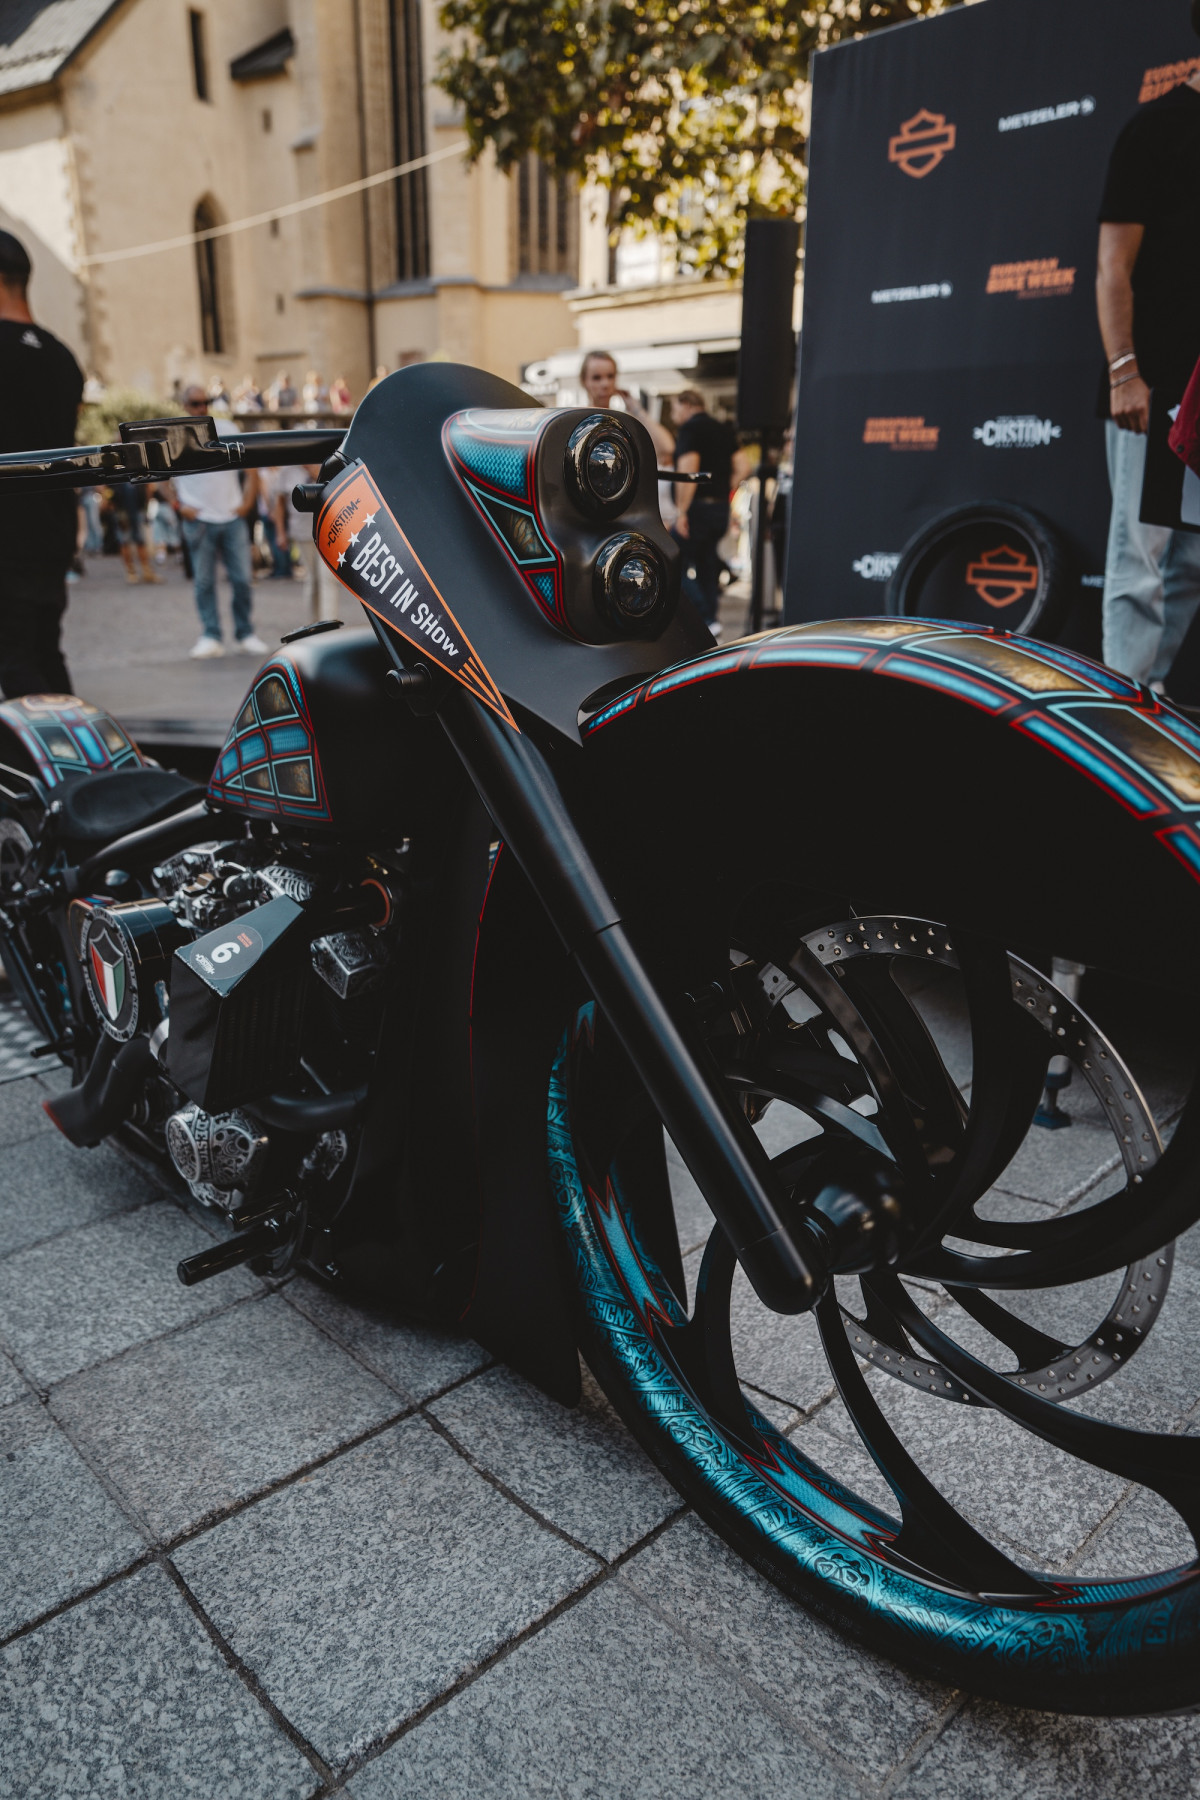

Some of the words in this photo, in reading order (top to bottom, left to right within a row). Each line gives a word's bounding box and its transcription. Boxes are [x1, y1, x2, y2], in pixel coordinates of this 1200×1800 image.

[998, 100, 1081, 132] METZELER
[871, 284, 939, 303] METZELER
[986, 275, 1025, 294] BIKE
[1027, 267, 1077, 289] WEEK
[897, 427, 940, 442] WEEK
[982, 418, 1052, 446] CUSTOM
[329, 502, 358, 543] CUSTOM
[861, 553, 901, 580] CUST
[351, 532, 404, 595] BEST
[389, 578, 419, 614] IN
[410, 603, 459, 657] SHOW
[211, 942, 241, 964] 6
